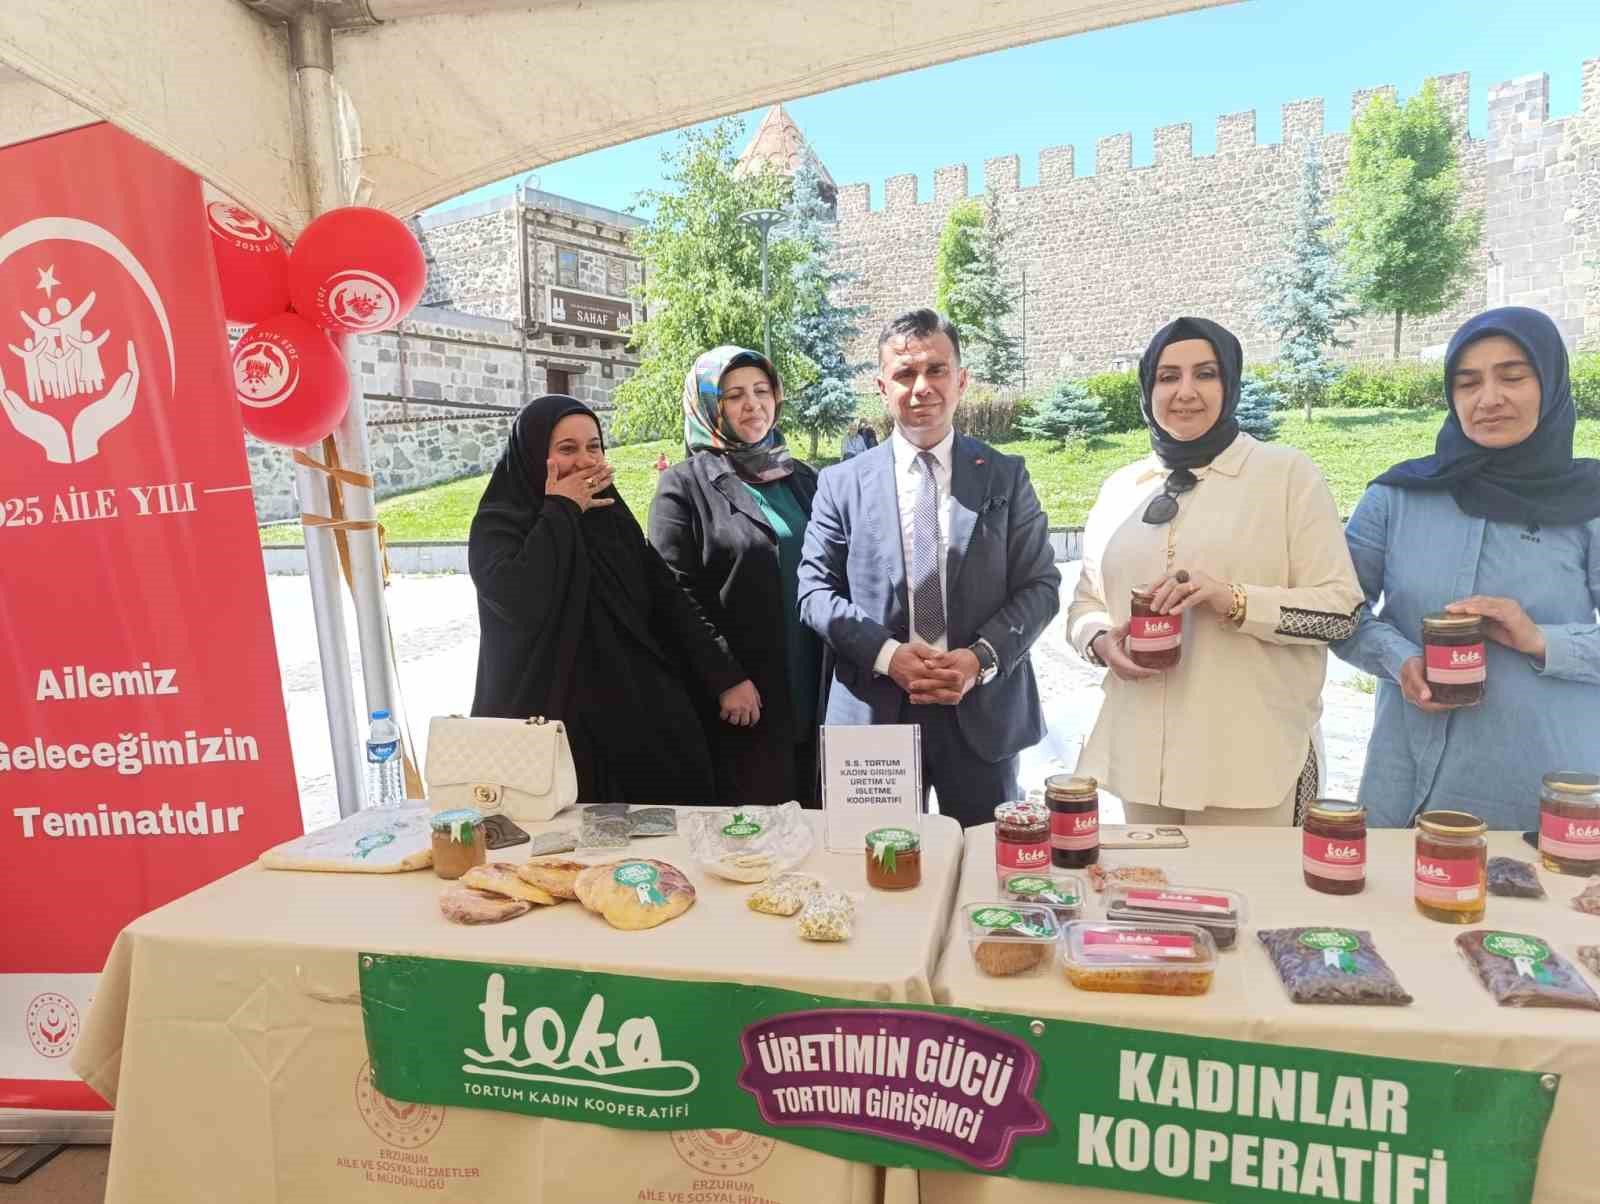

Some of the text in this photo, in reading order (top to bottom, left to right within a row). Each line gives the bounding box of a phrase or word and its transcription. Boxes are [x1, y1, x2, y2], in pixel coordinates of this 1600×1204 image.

[576, 310, 608, 328] SAHAF
[52, 485, 119, 523] AİLE
[128, 482, 197, 516] YILI
[36, 662, 179, 700] Ailemiz
[13, 801, 244, 838] Teminatıdır
[464, 973, 680, 1080] toka
[758, 1026, 1014, 1107] ÜRETİMİN GÜCÜ
[464, 1083, 689, 1118] TORTUM KADIN KOOPERATİFİ
[1118, 1049, 1409, 1135] KADINLAR
[772, 1084, 984, 1144] TORTUM GİRİŞİMCİ
[360, 1159, 375, 1170] VE
[376, 1160, 415, 1176] SOSYAL
[416, 1166, 480, 1177] HİZMETLER
[379, 1149, 430, 1164] ERZURUM
[1077, 1113, 1447, 1204] KOOPERATİFİ
[637, 1187, 665, 1201] AİLE
[668, 1191, 685, 1203] VE
[687, 1192, 734, 1204] SOSYAL
[692, 1179, 755, 1193] ERZURUM
